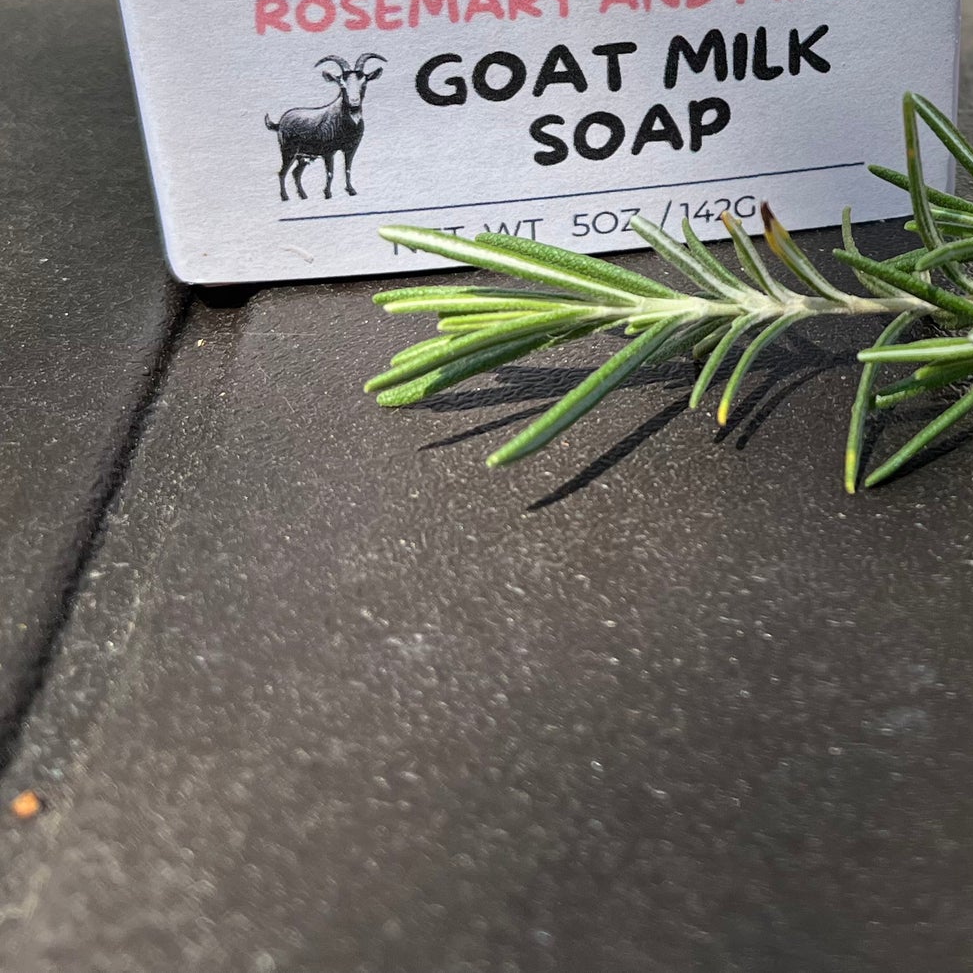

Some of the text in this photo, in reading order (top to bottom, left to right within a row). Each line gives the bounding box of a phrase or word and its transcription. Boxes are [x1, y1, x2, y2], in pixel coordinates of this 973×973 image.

[415, 24, 832, 107] GOAT MILK
[529, 96, 732, 167] SOAP
